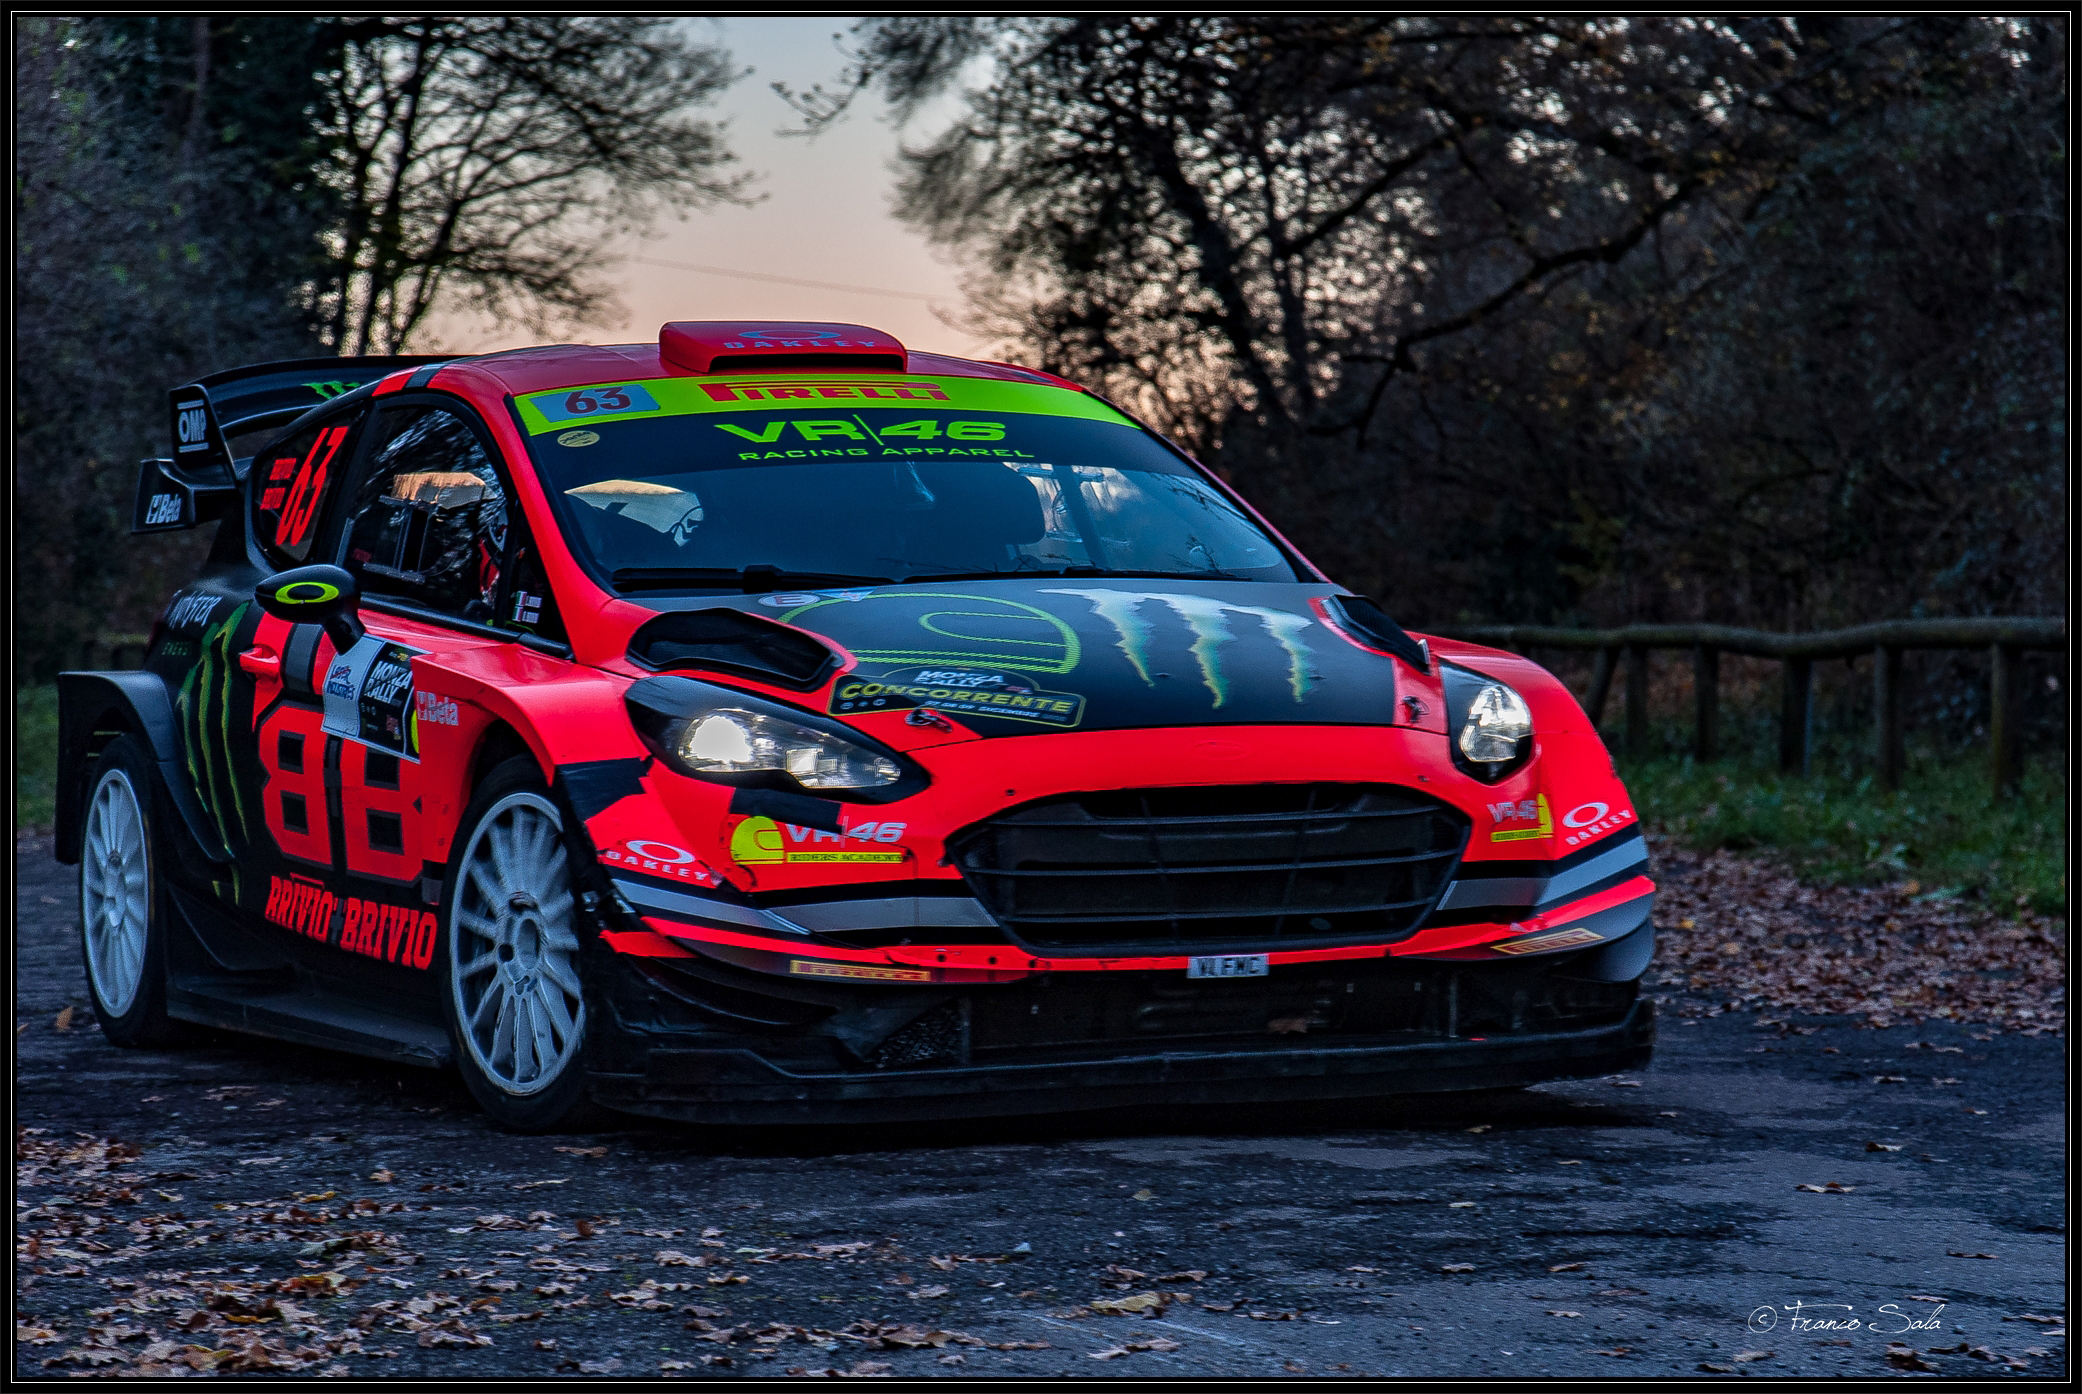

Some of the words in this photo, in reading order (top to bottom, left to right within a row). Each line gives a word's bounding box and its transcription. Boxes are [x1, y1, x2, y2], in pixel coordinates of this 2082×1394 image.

[723, 340, 875, 349] OAKLEY
[564, 387, 631, 414] 63
[698, 381, 951, 402] PIRELLI
[178, 409, 207, 443] OMP
[738, 448, 869, 461] RACING
[882, 447, 1034, 458] APPAREL
[276, 426, 348, 546] 63
[371, 660, 414, 690] MONZA
[363, 678, 399, 704] RALLY
[840, 683, 1076, 713] CONCORRENTE
[427, 692, 459, 726] Beta
[1565, 810, 1632, 845] OAKLEY
[606, 850, 709, 881] OAKLEY
[340, 897, 438, 971] BRIVIO
